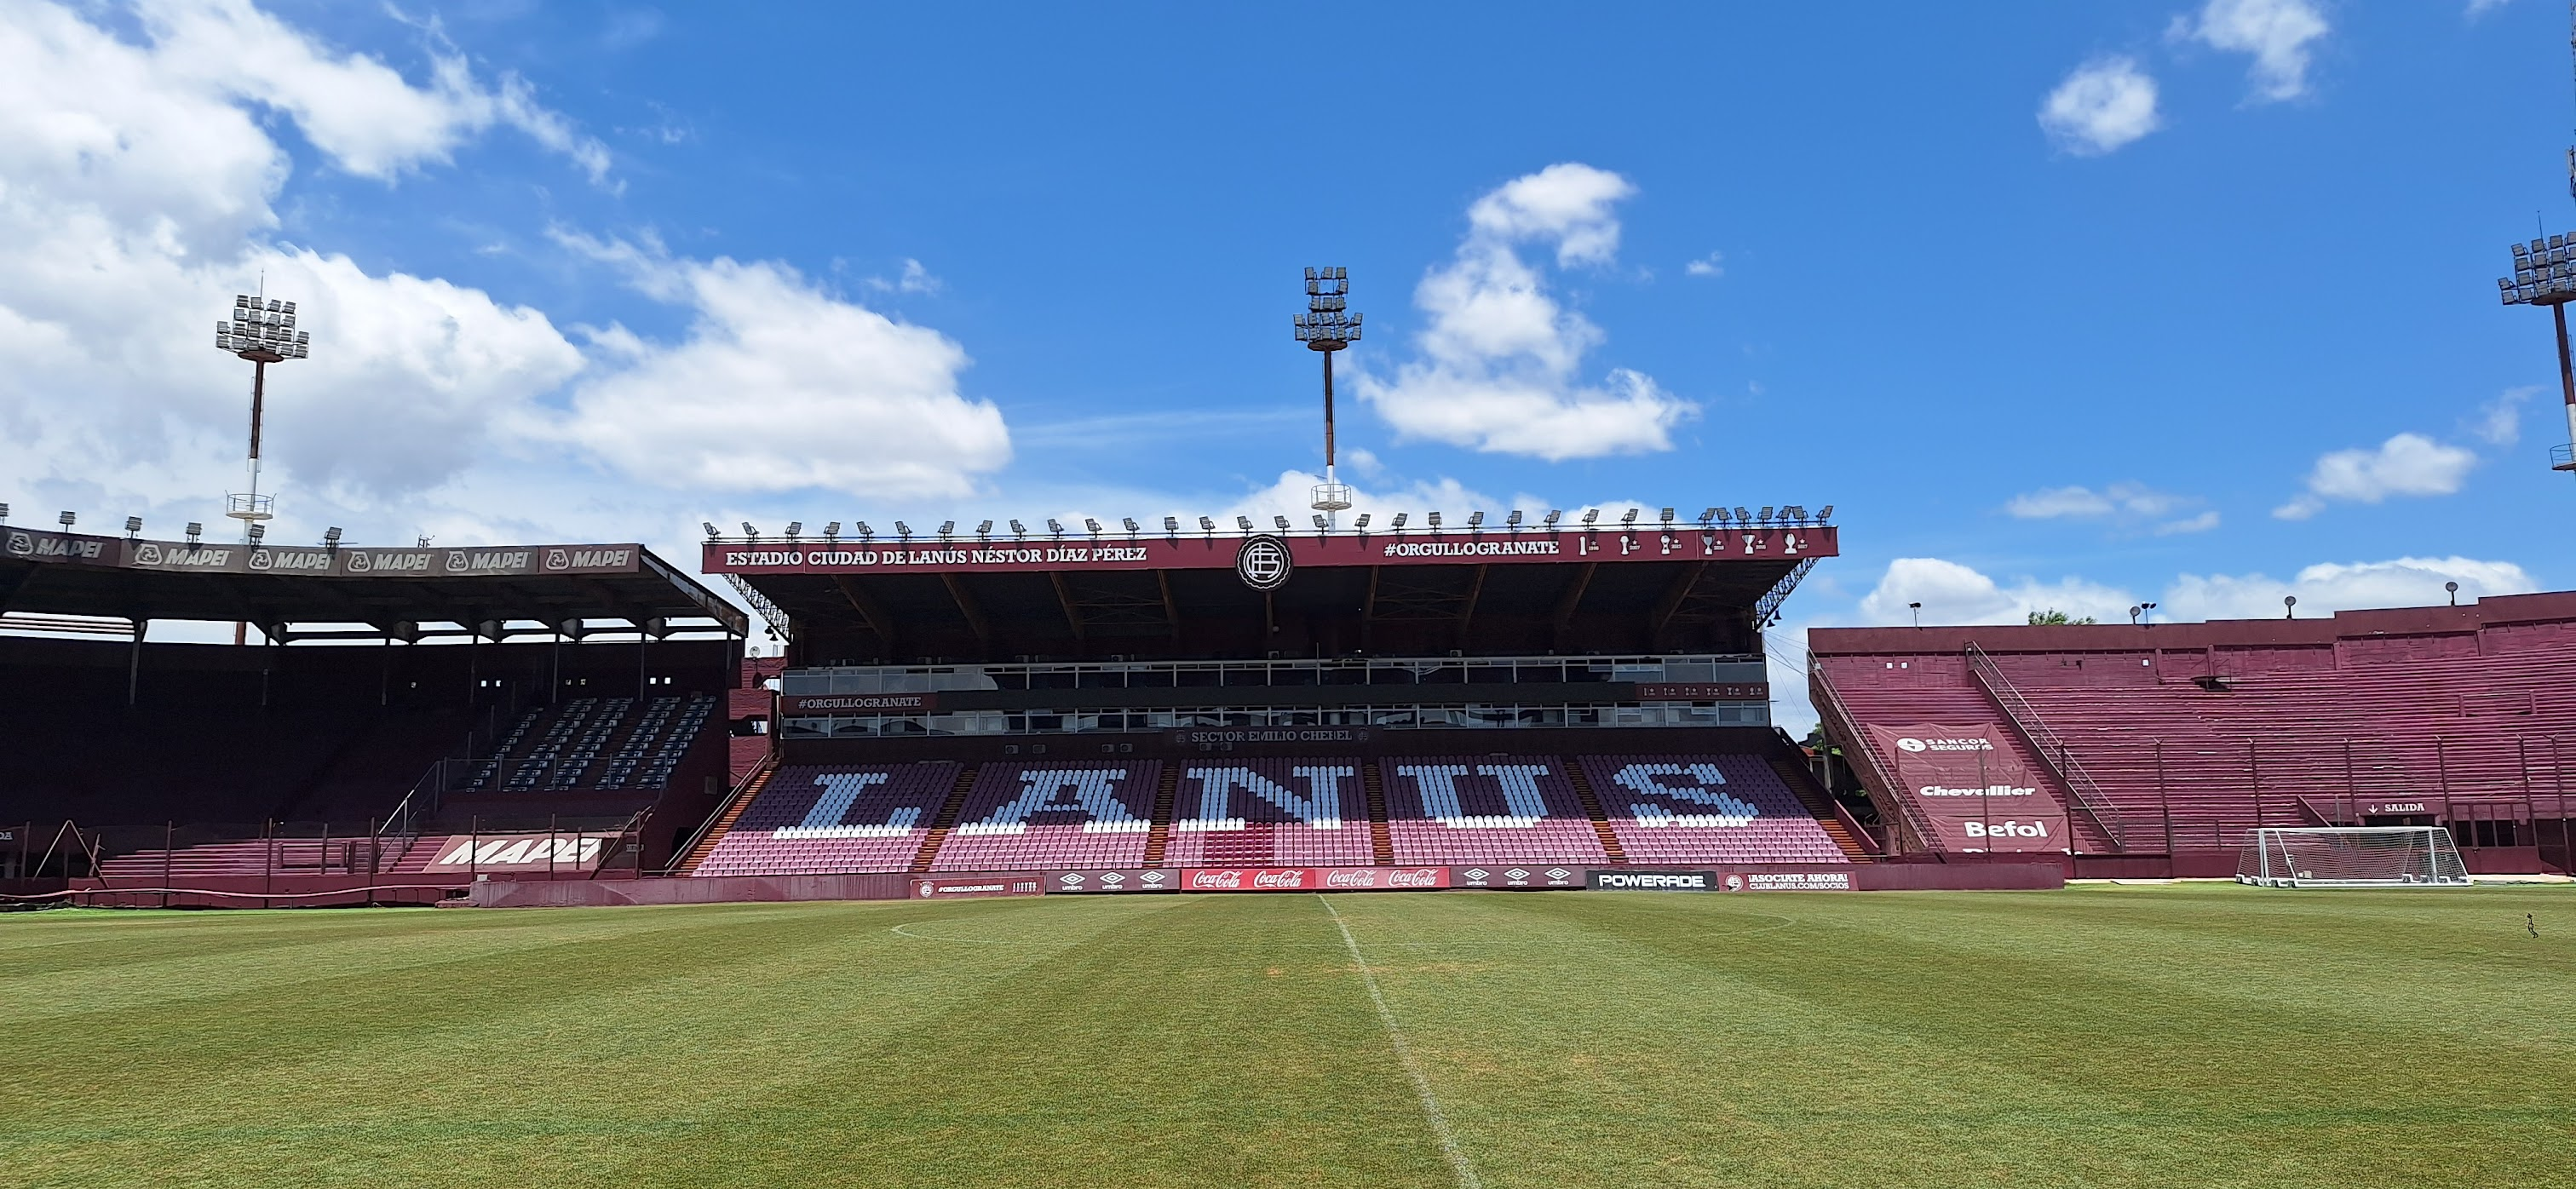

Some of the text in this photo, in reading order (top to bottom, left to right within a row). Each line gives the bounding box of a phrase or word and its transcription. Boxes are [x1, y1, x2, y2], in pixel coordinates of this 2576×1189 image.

[36, 537, 105, 559] MAPEI
[726, 544, 1147, 566] ESTADIO CIUDAD DE LANÚS NÉSTOR DÍAZ PÉREZ
[1384, 542, 1560, 557] #ORGULLOGRANATE
[164, 549, 230, 566] MAPEI
[273, 552, 333, 570] MAPEI
[372, 554, 434, 571] MAPEI
[471, 553, 531, 570] MAPEI
[572, 550, 633, 568] MAPEI
[797, 697, 922, 709] #ORGULLOGRANATE
[1191, 732, 1245, 743] SECTOR
[1248, 730, 1297, 742] EMILIO
[1919, 785, 2036, 797] Chevallier
[773, 762, 1760, 840] LANUS
[2384, 803, 2425, 812] SALIDA
[1964, 820, 2049, 838] Befol
[438, 838, 601, 864] MAPEI
[1598, 875, 1706, 887] POWERADE
[1747, 874, 1849, 882] ¡ASOCIATE AHORA!
[938, 884, 1005, 893] #ORGULLOGRANATE
